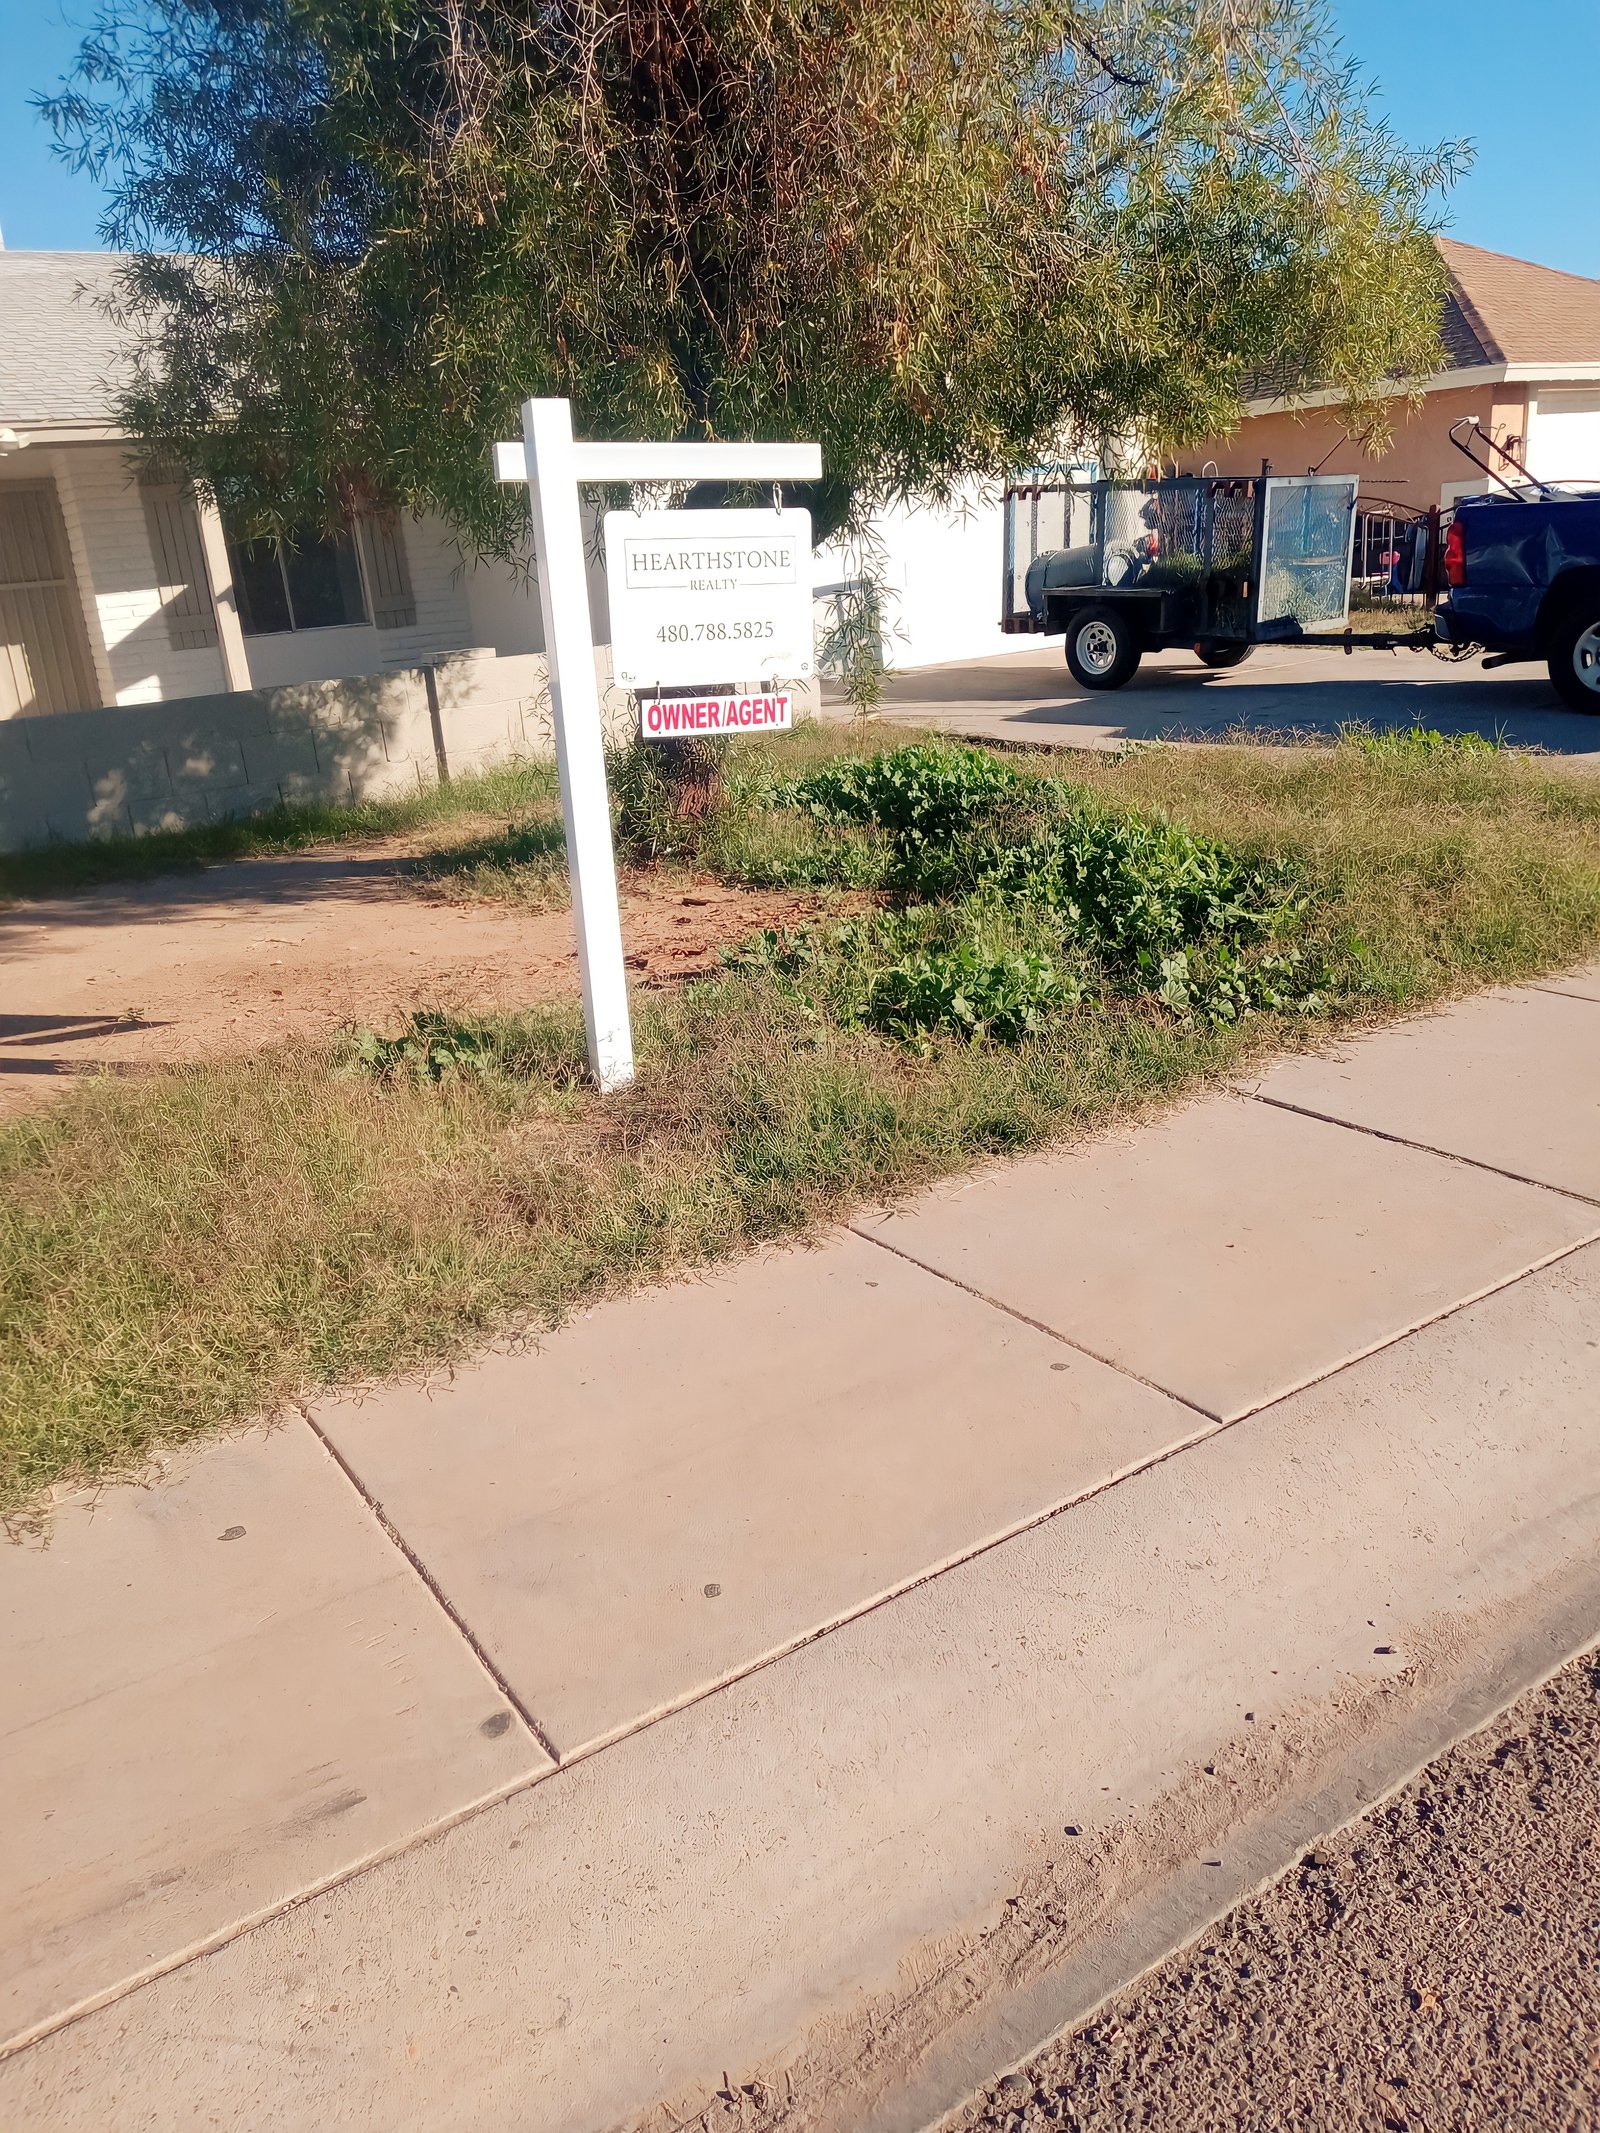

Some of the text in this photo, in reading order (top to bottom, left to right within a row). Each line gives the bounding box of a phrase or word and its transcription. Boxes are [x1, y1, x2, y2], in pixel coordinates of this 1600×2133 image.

[632, 550, 791, 571] HEARTHSTONE
[690, 579, 737, 591] REALTY
[656, 621, 774, 643] 480.788.5825
[647, 697, 788, 731] OWNER/AGENT
